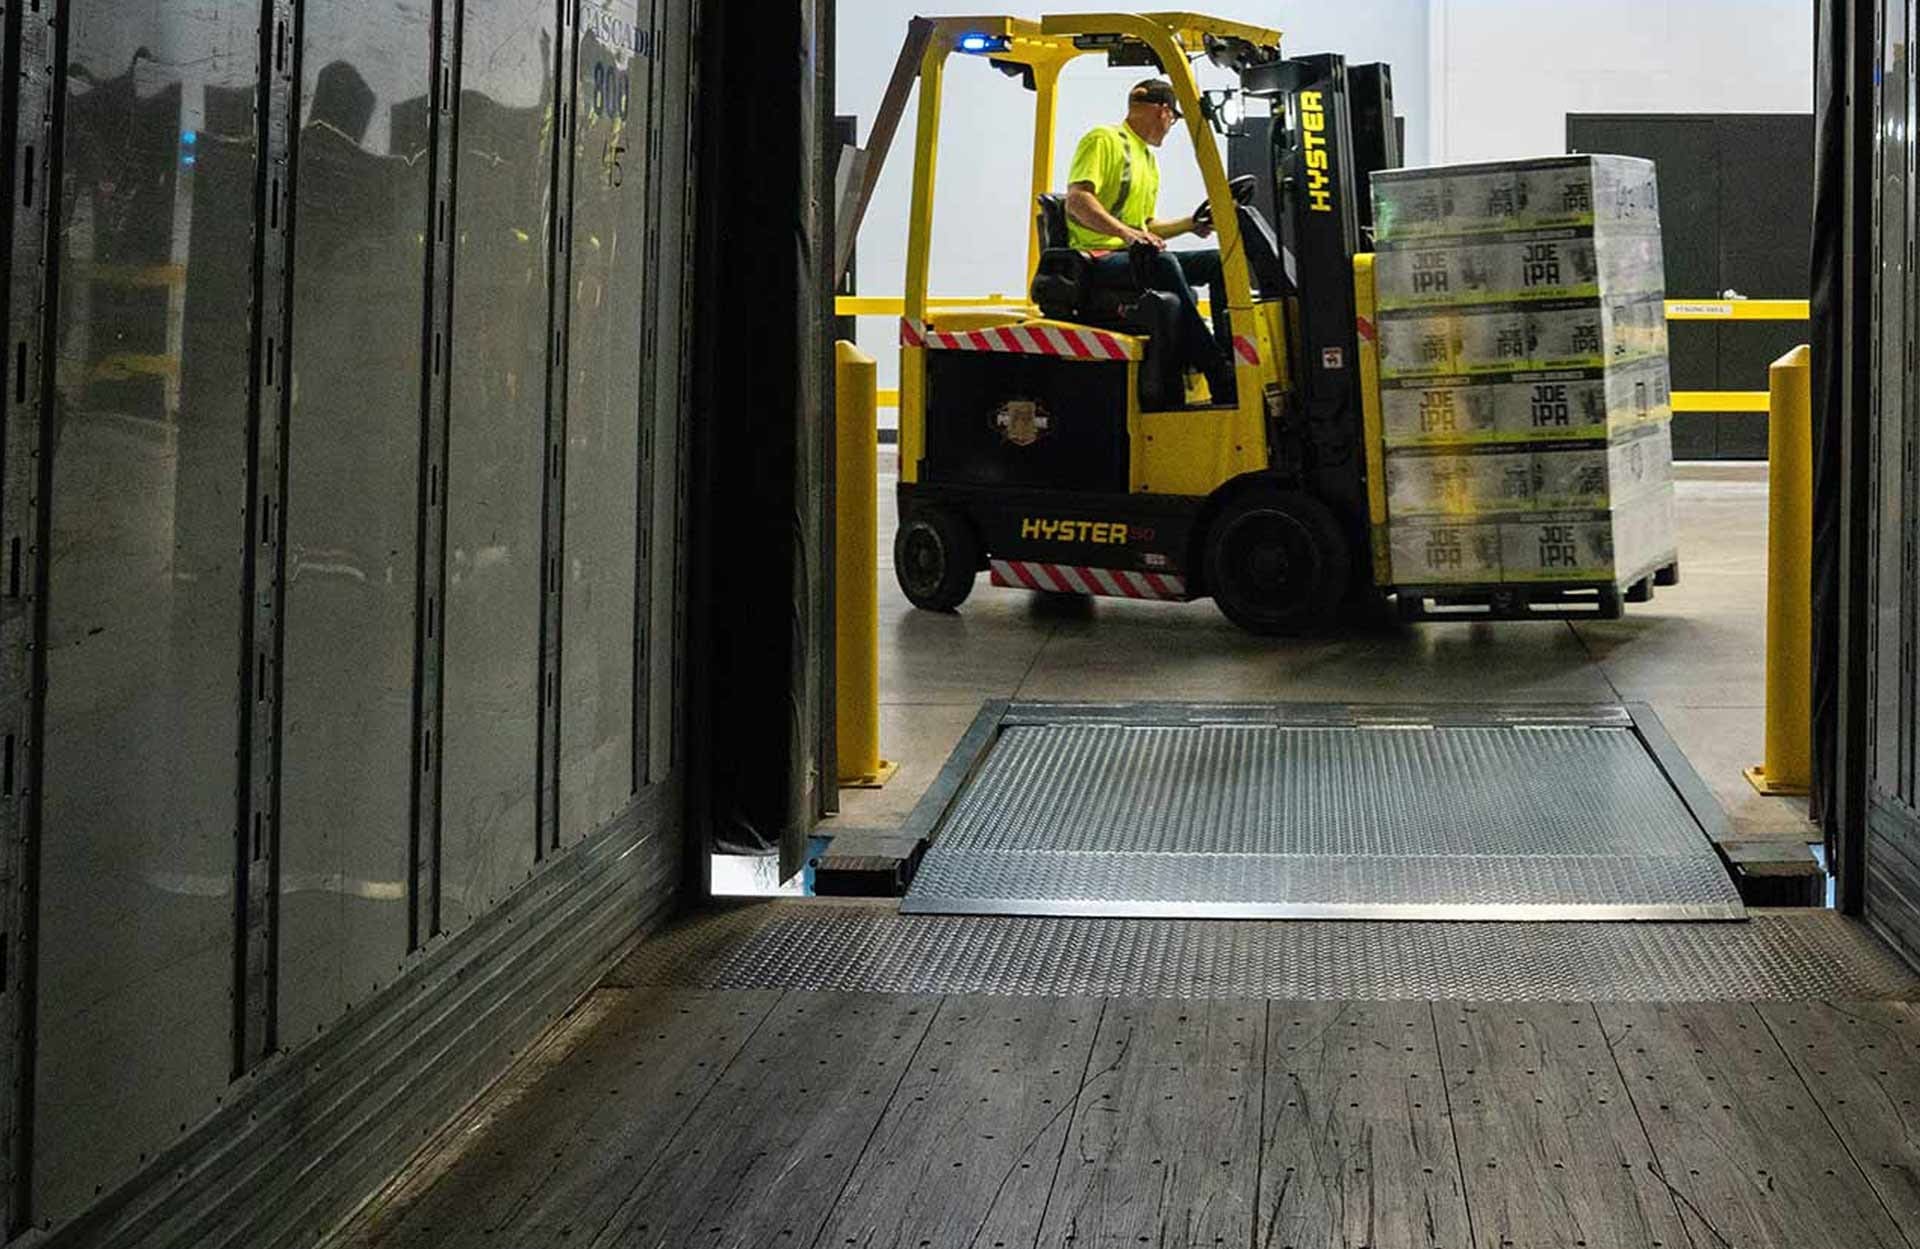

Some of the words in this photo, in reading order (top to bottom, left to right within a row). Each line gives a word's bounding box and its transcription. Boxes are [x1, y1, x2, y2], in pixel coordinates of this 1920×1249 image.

[1302, 90, 1331, 211] HYSTER
[1489, 202, 1512, 217] IPA
[1563, 197, 1588, 212] IPA
[1413, 252, 1446, 269] JOE
[1523, 245, 1558, 262] JOE
[1413, 271, 1448, 293] IPA
[1523, 263, 1560, 286] IPA
[1573, 325, 1598, 337] JOE
[1423, 347, 1447, 361] IPA
[1497, 343, 1522, 357] IPA
[1573, 339, 1599, 353] IPA
[1420, 391, 1454, 408] JOE
[1531, 385, 1567, 403] JOE
[1420, 410, 1456, 432] IPA
[1532, 405, 1569, 426] IPA
[1021, 518, 1128, 544] HYSTER
[1427, 529, 1460, 546] JOE
[1539, 526, 1574, 544] JOE
[1427, 549, 1462, 568] IPA
[1540, 545, 1577, 567] IPA
